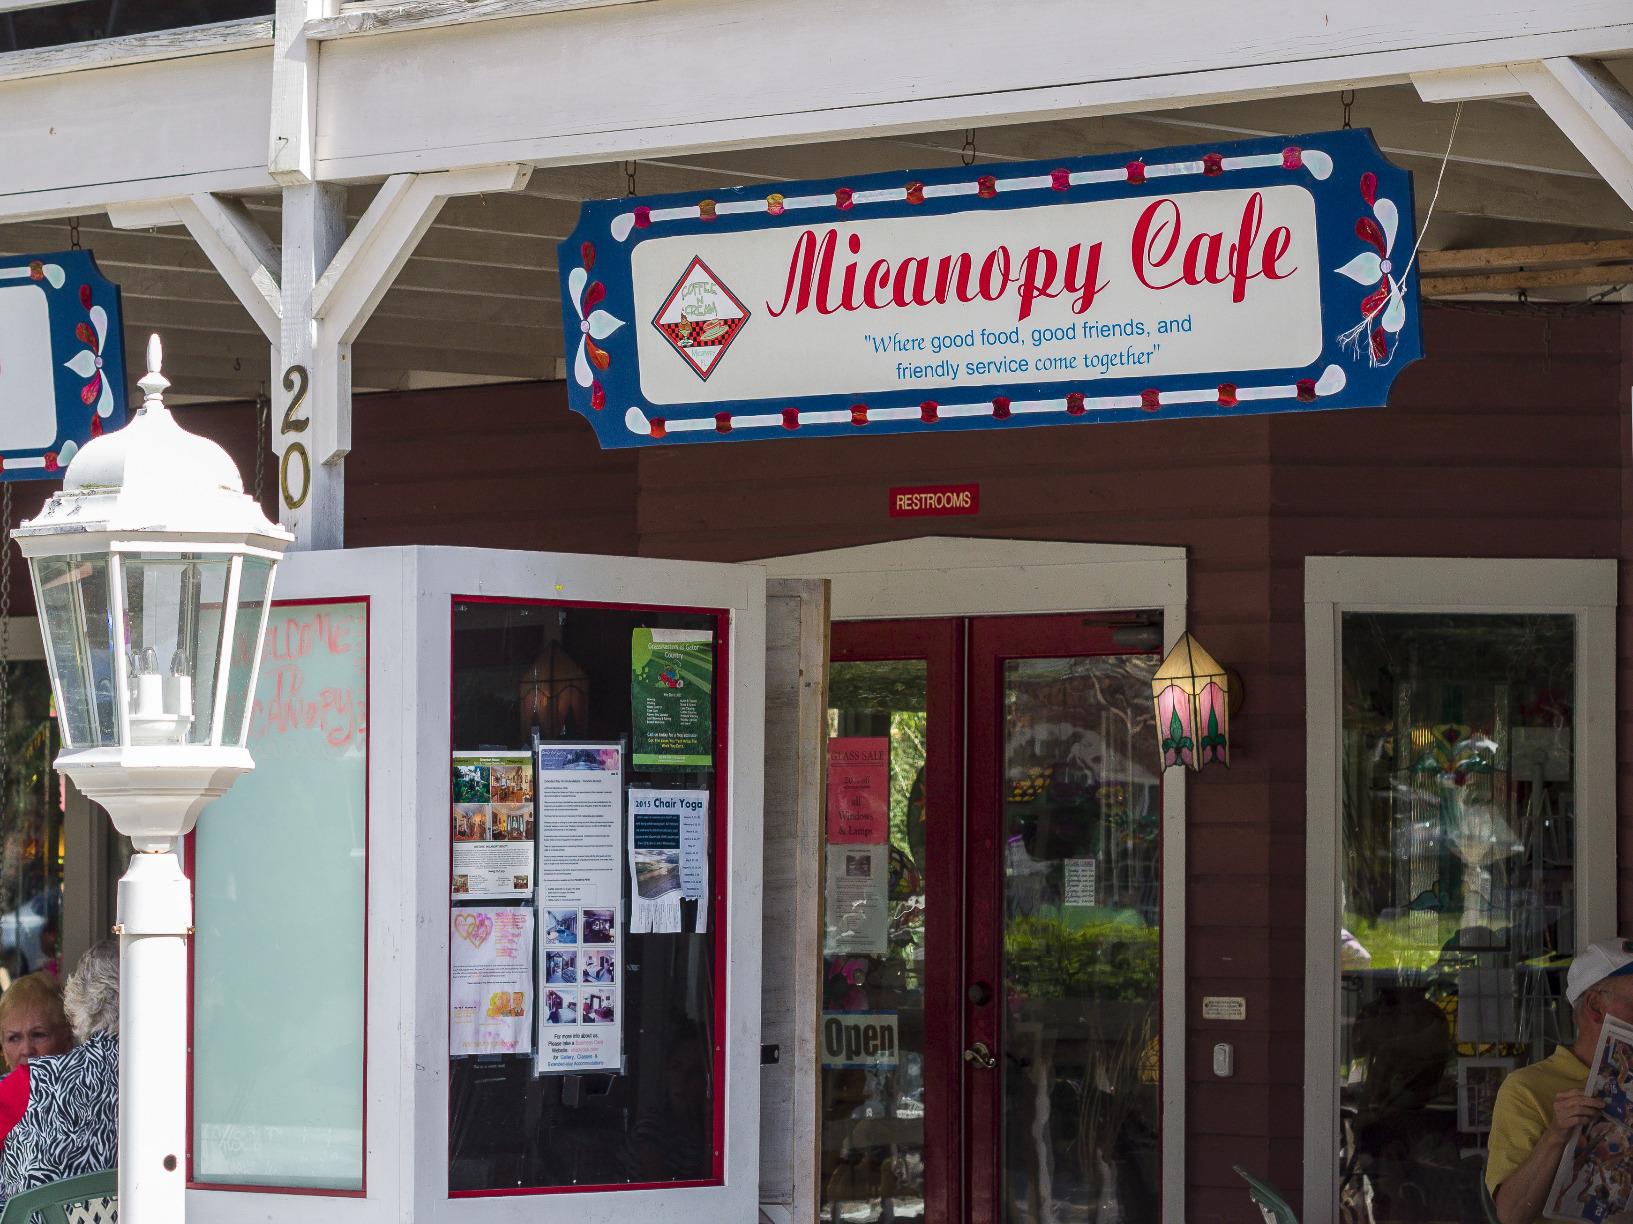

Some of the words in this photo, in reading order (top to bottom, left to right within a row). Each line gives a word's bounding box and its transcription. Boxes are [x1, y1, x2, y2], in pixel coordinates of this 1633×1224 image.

[765, 228, 1110, 322] Micanopy
[1131, 191, 1298, 303] Cafe
[864, 332, 927, 354] "Where
[931, 329, 975, 354] good
[980, 326, 1025, 347] food,
[1031, 321, 1076, 347] good
[1082, 318, 1150, 339] friends,
[1157, 313, 1192, 334] and
[895, 359, 960, 381] friendly
[966, 355, 1029, 376] service
[1034, 355, 1078, 372] come
[1082, 343, 1161, 375] together"
[896, 491, 971, 510] RESTROOMS
[664, 651, 684, 660] Country
[635, 800, 651, 808] 2015
[653, 797, 677, 809] Chair
[679, 798, 703, 811] Yoga
[824, 1017, 895, 1061] Open
